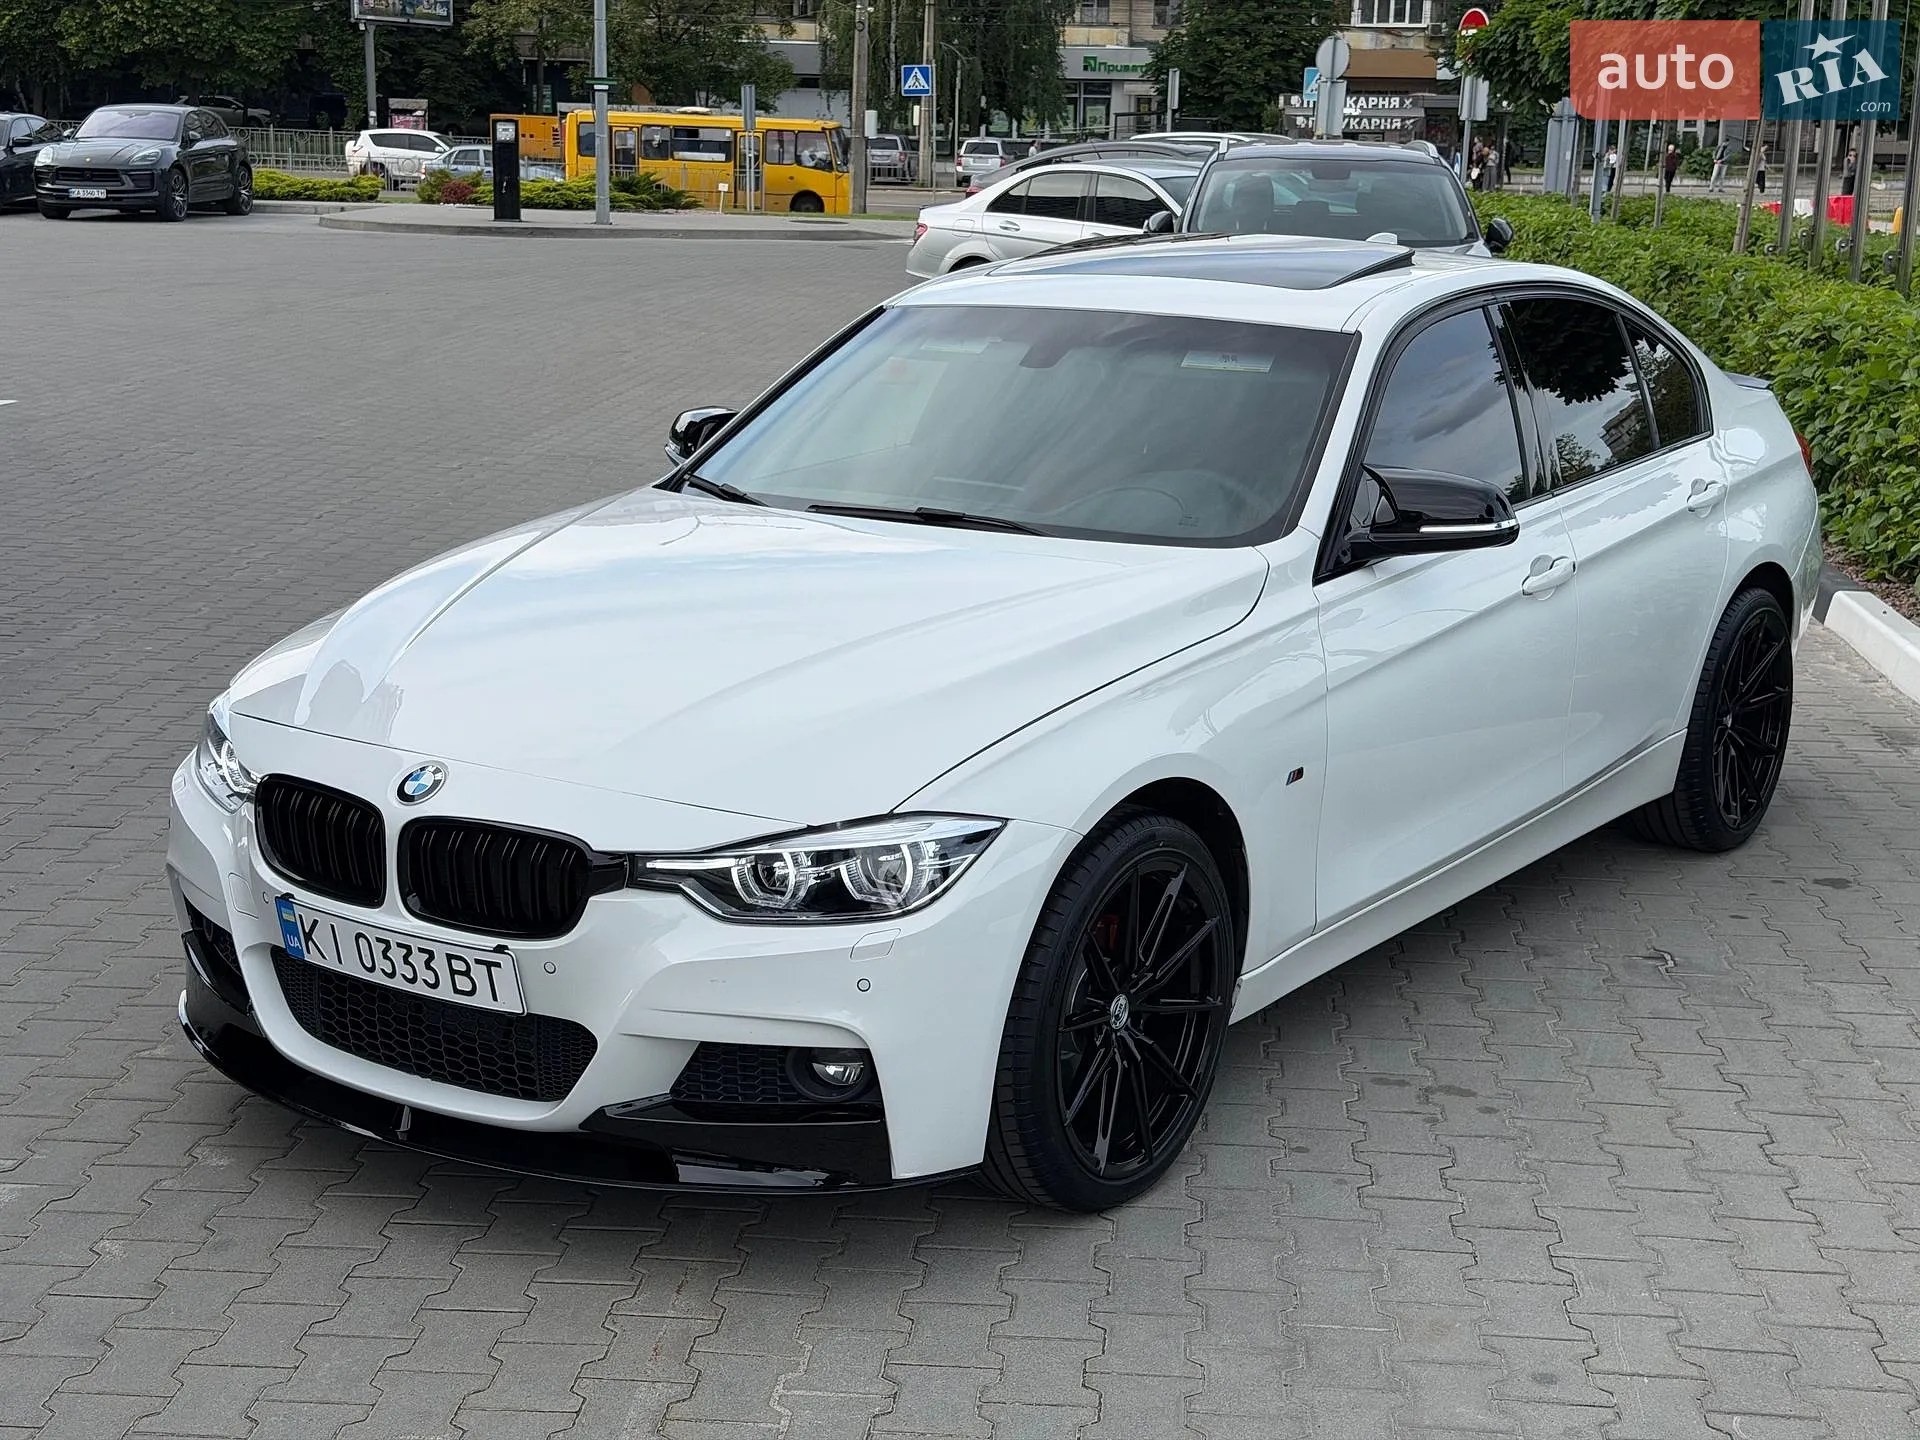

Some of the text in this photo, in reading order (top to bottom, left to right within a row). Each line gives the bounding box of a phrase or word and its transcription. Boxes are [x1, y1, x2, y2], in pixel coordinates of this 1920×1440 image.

[1098, 61, 1147, 74] Приват
[287, 935, 301, 948] UA
[298, 913, 502, 1003] KI 0333 BT
